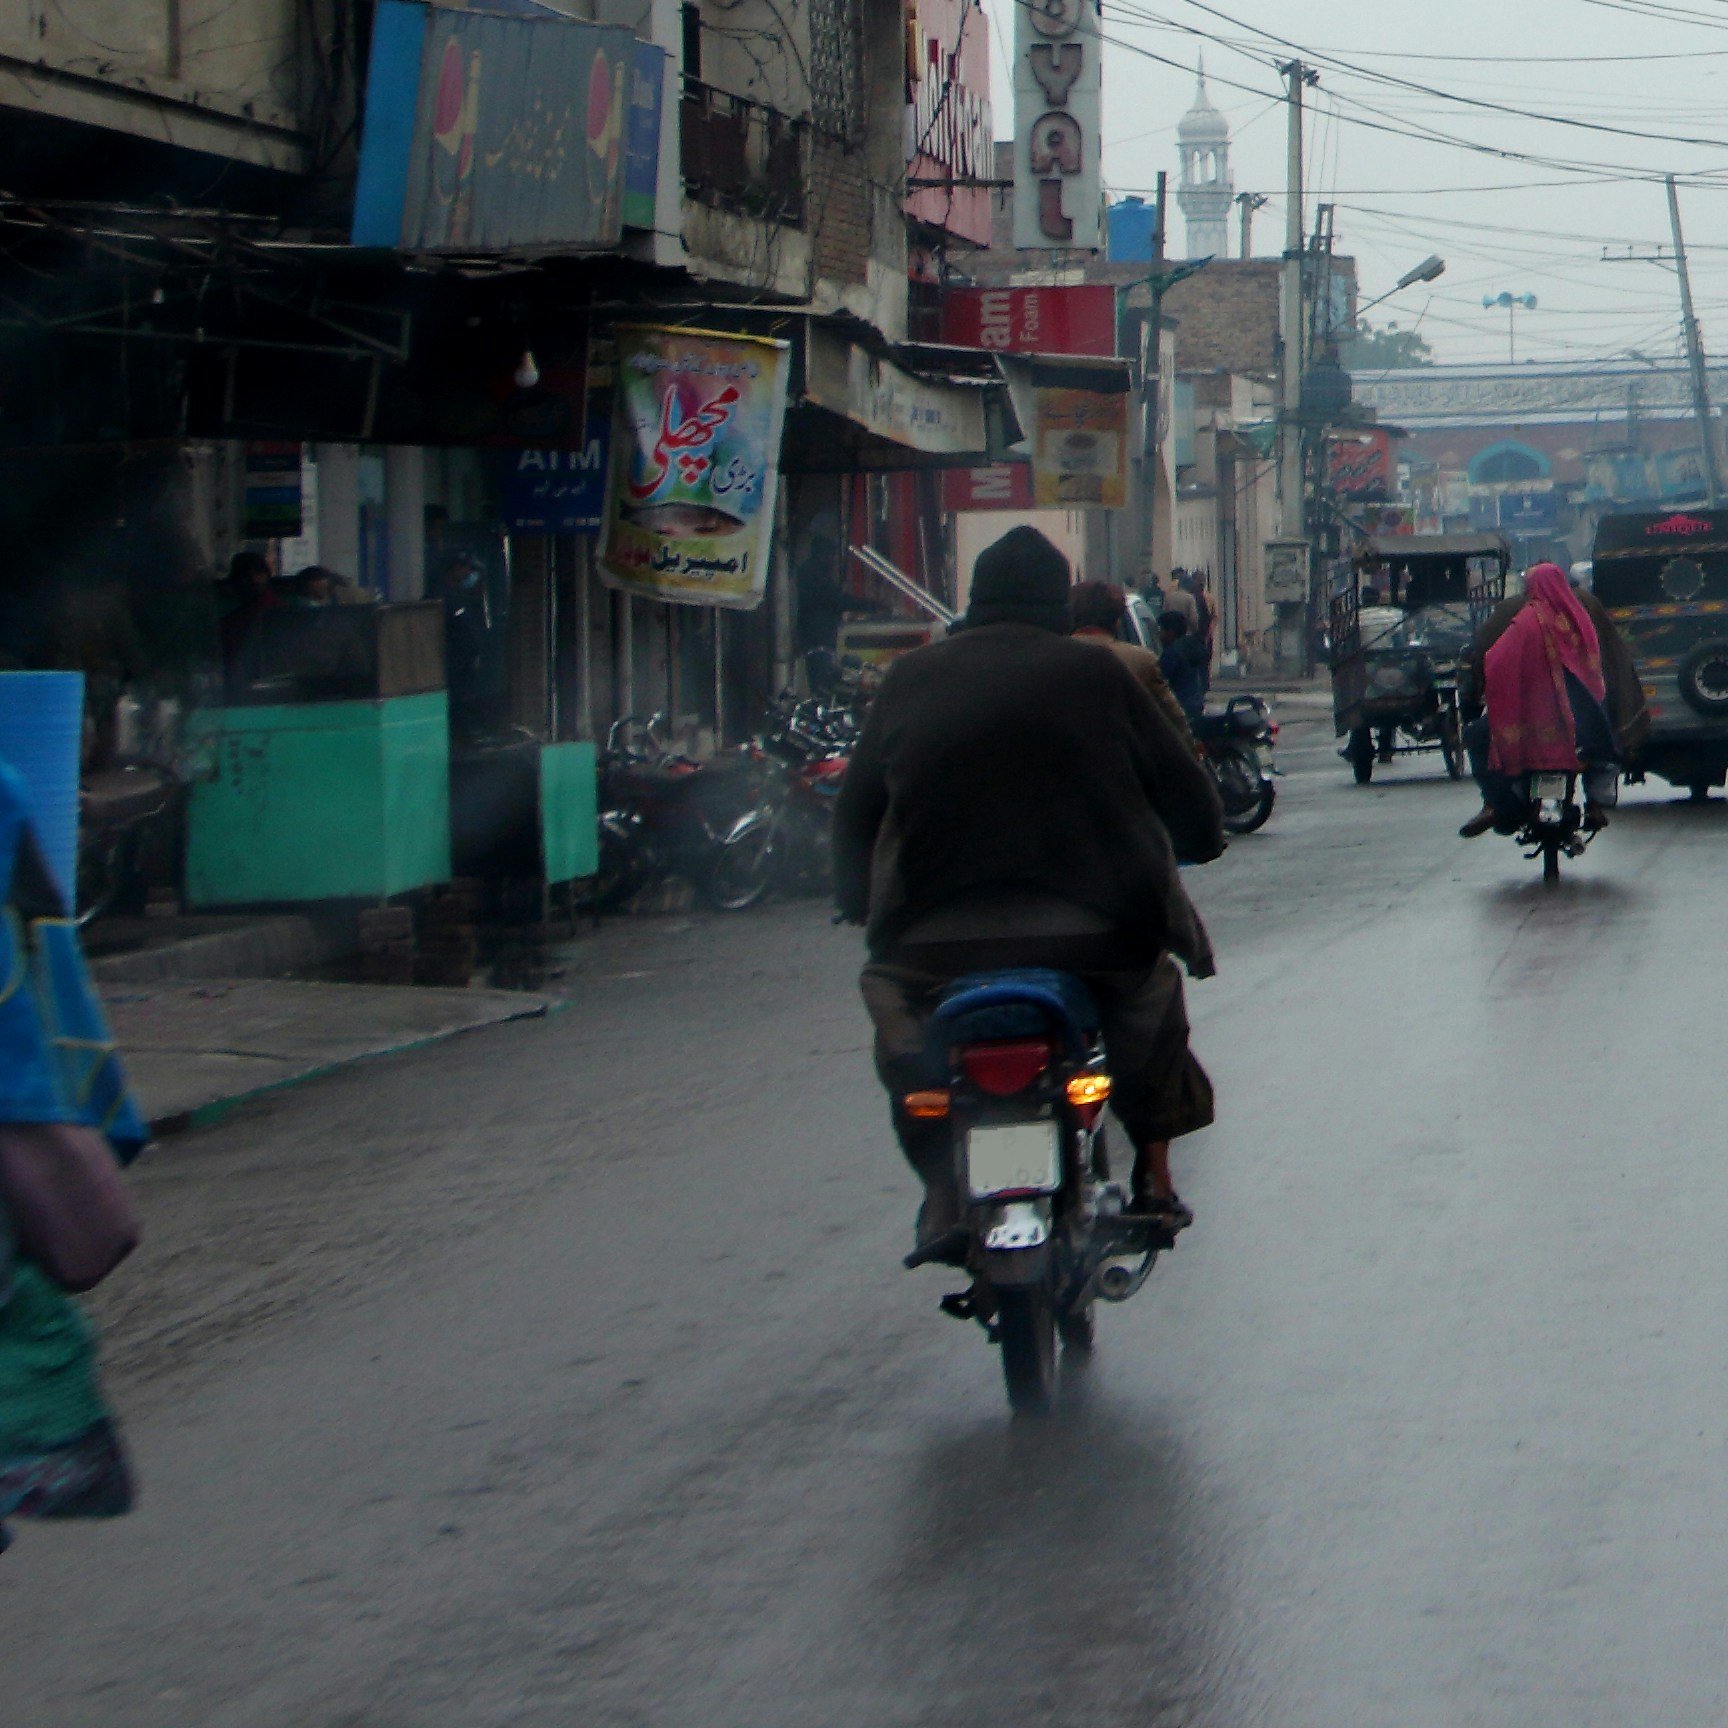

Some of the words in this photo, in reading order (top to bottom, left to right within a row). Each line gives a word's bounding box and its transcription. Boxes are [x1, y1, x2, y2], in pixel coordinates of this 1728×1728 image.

[1019, 293, 1040, 343] Foam
[626, 382, 741, 501] مچھلی
[709, 457, 757, 495] بڑی
[1644, 514, 1713, 536] UNIQUE
